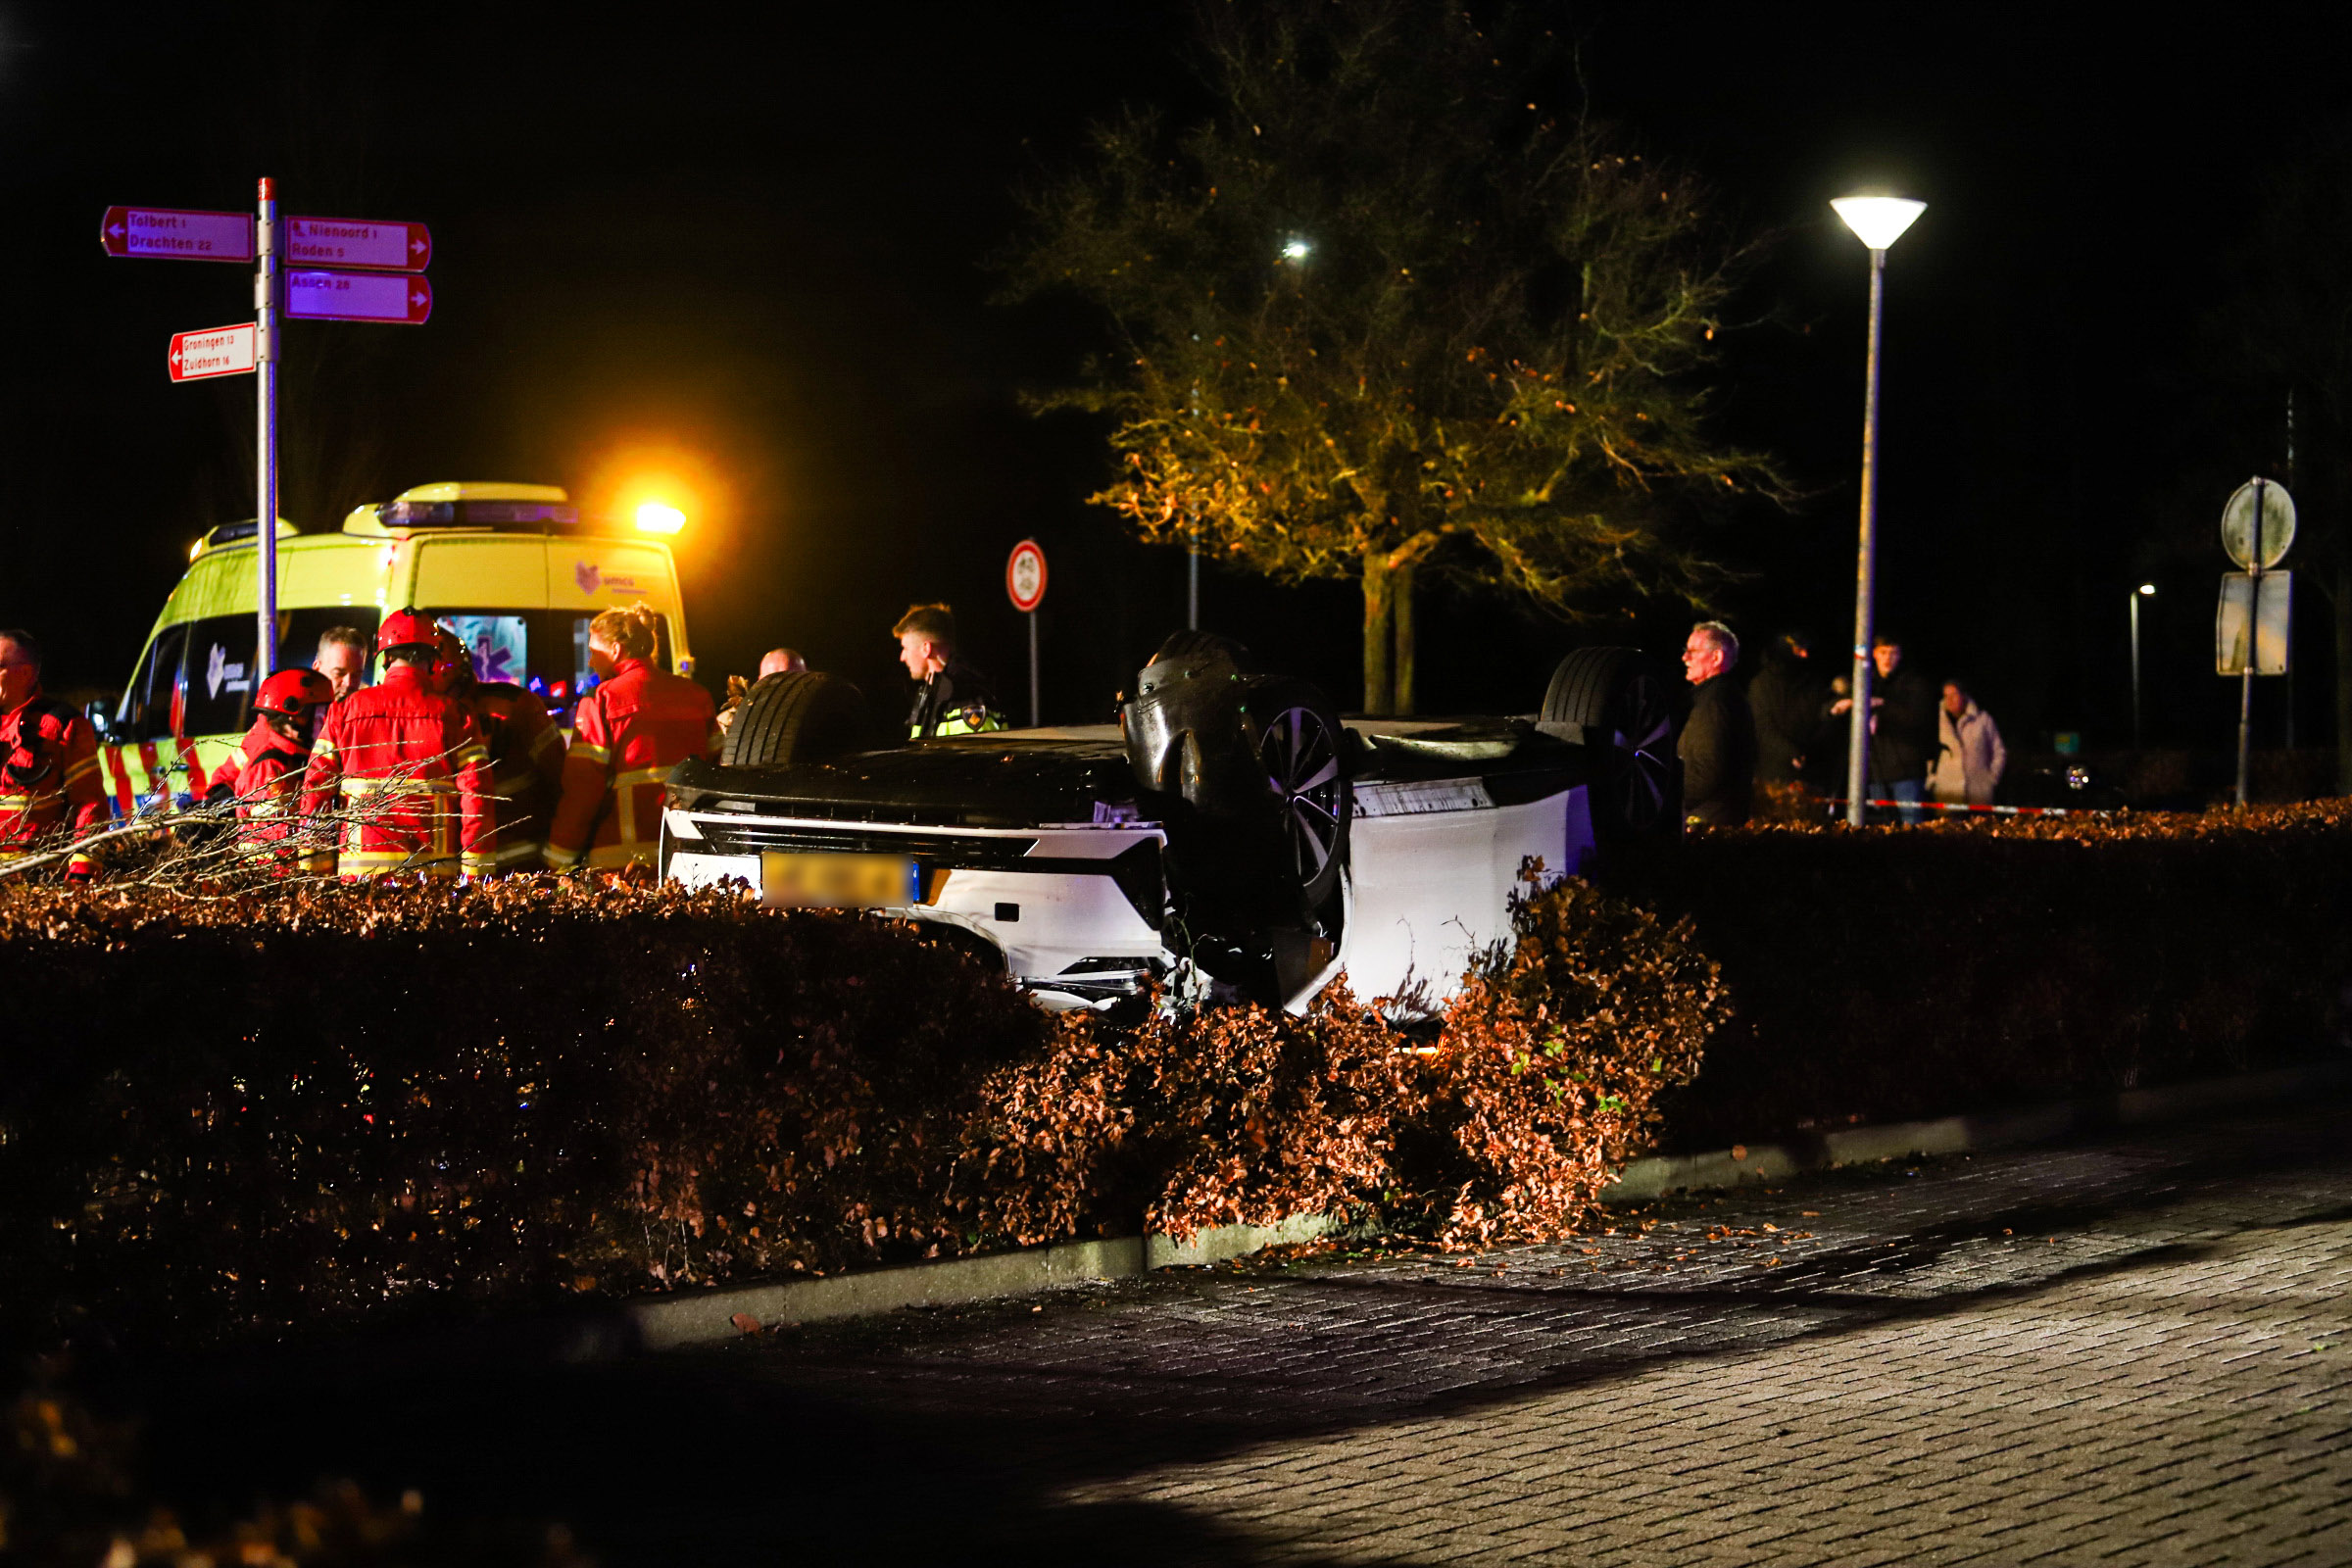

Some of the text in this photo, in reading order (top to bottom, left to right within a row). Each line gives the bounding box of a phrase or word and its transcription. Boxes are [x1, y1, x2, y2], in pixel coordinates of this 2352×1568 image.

[130, 214, 176, 227] Tolbert
[310, 223, 368, 239] Nienoord
[130, 234, 212, 251] Drachten 22
[292, 242, 332, 256] Roden
[292, 275, 332, 290] Assen
[183, 335, 234, 351] Groningen 13
[183, 356, 230, 370] Zuidhorn 16
